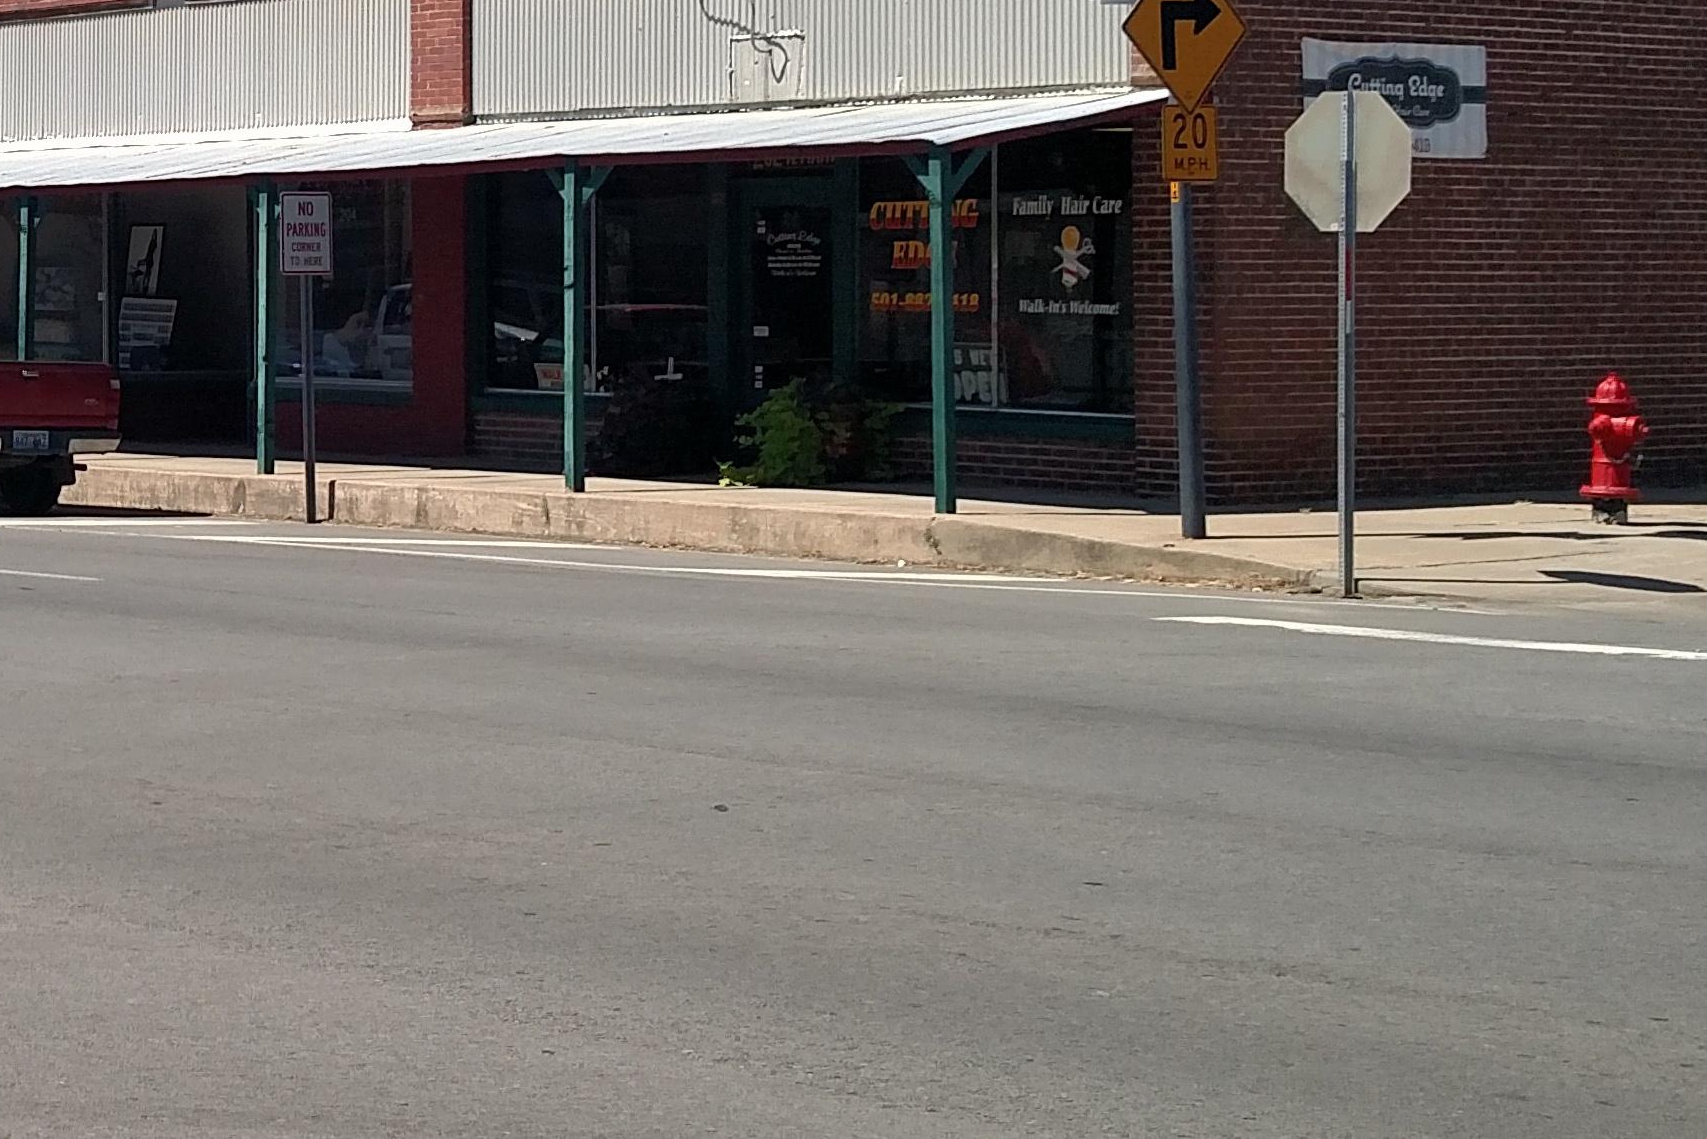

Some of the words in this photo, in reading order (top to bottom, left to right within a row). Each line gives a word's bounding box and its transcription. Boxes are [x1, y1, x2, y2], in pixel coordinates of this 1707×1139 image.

[1408, 75, 1446, 103] Edge
[1173, 112, 1208, 150] 20
[298, 201, 314, 216] NO
[1012, 195, 1054, 220] Family
[1060, 195, 1090, 215] Hair
[1092, 196, 1123, 214] Care
[286, 222, 326, 237] PARKING
